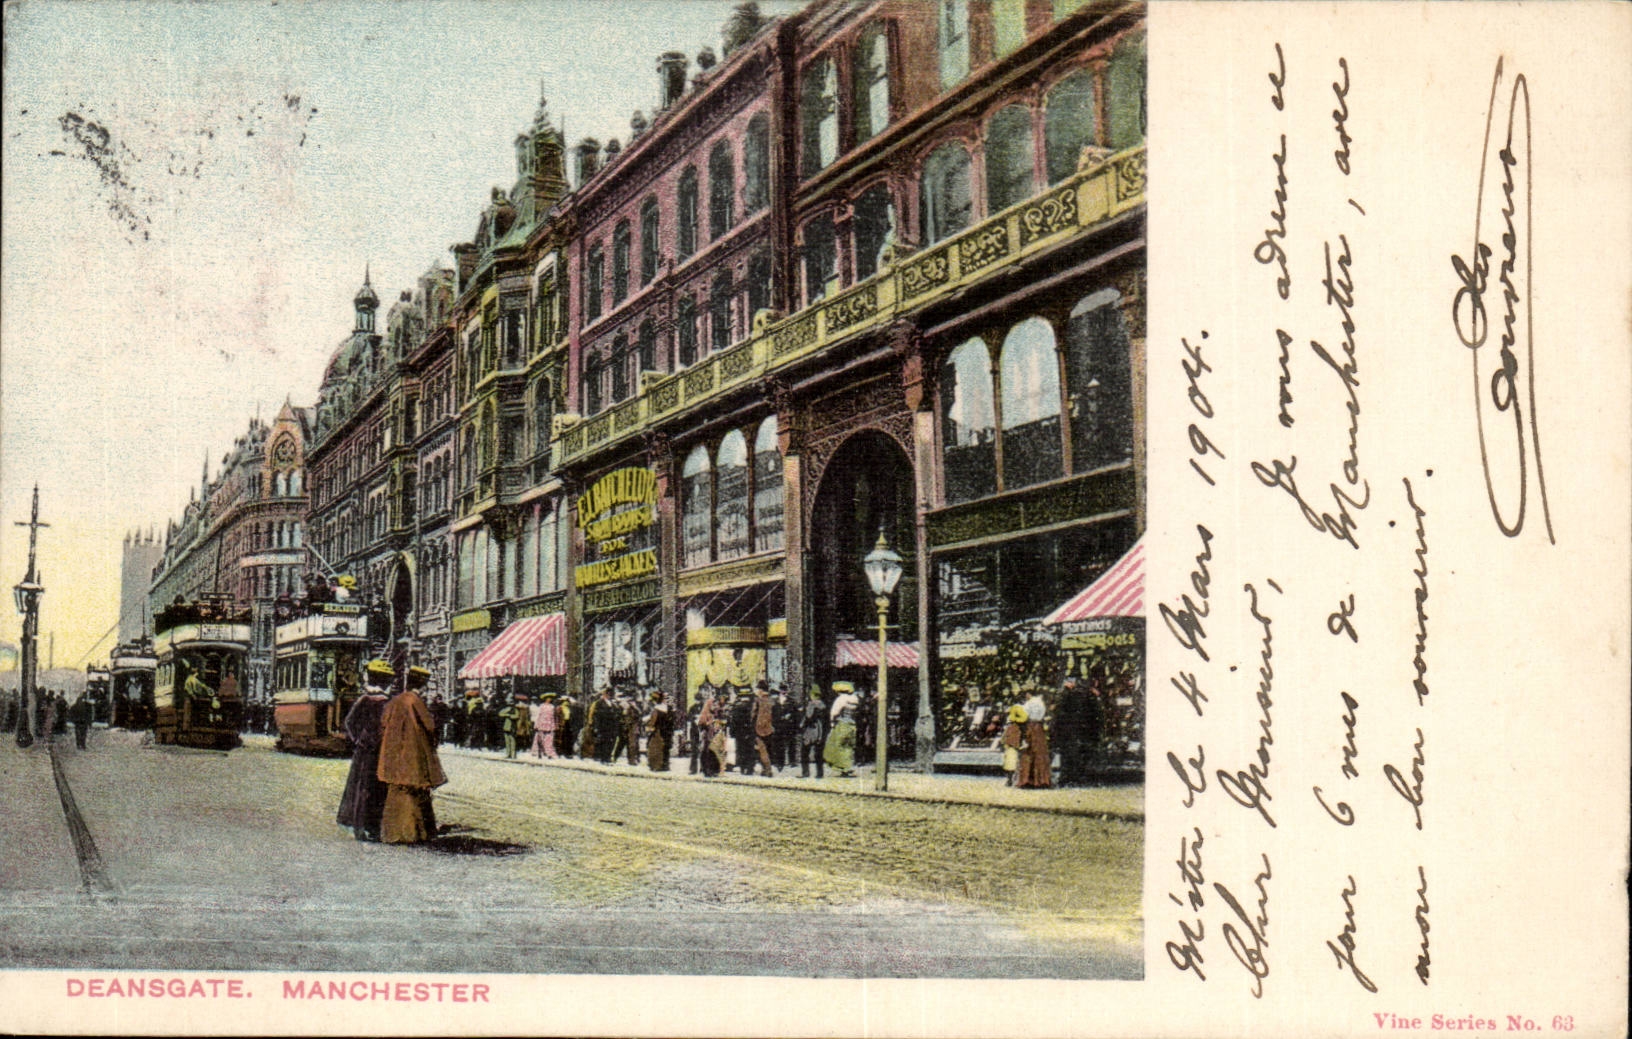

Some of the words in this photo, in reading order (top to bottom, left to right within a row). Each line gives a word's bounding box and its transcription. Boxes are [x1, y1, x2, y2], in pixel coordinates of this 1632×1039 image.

[1332, 57, 1353, 176] avec
[1276, 329, 1295, 428] vous
[1250, 456, 1319, 531] Je
[1158, 524, 1213, 663] Mars
[1327, 594, 1358, 643] de
[1171, 671, 1208, 717] 4
[1167, 745, 1206, 808] le
[1313, 786, 1354, 827] 6
[1383, 728, 1425, 831] bon
[1416, 866, 1431, 986] mon
